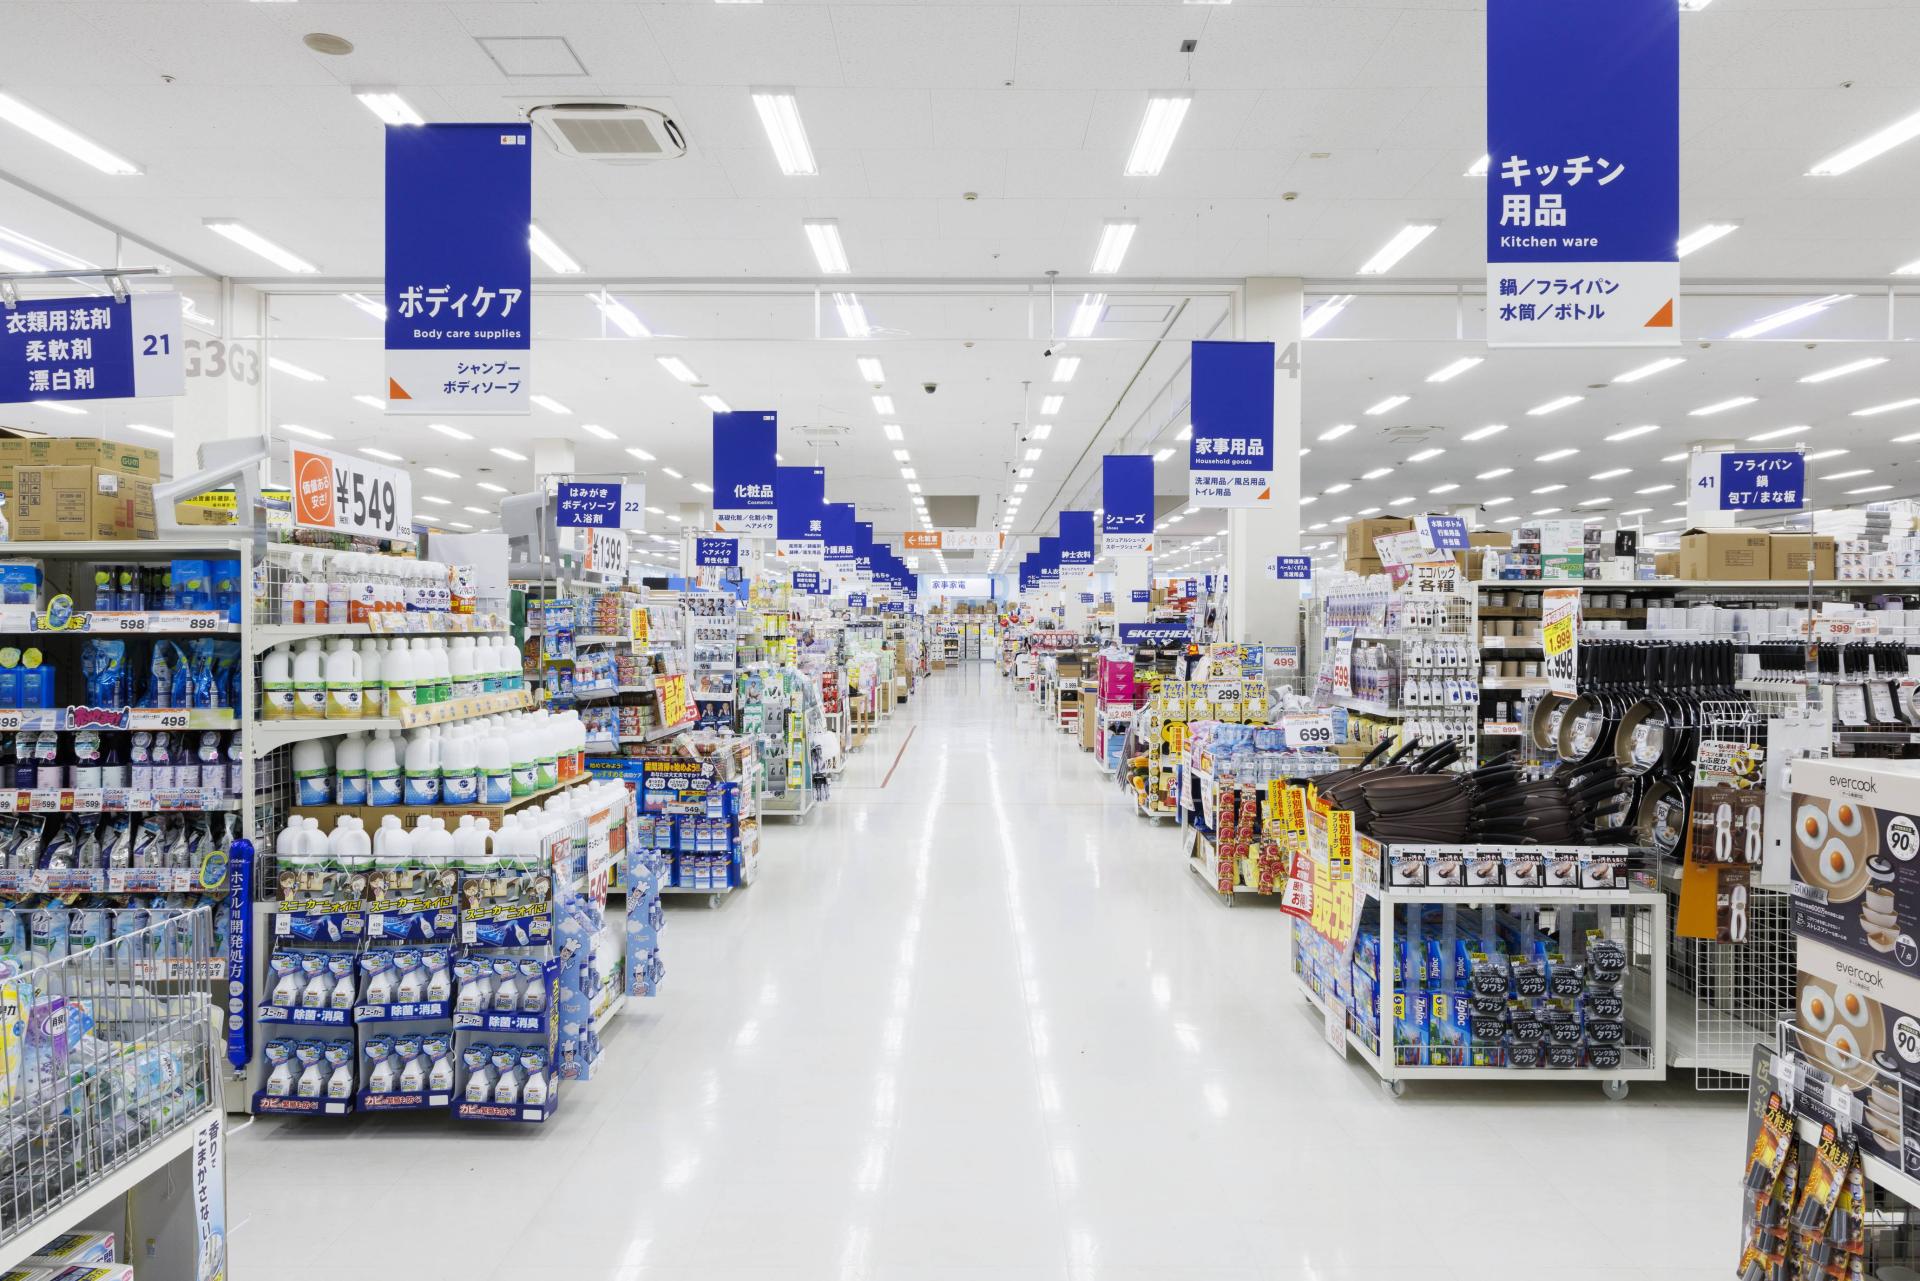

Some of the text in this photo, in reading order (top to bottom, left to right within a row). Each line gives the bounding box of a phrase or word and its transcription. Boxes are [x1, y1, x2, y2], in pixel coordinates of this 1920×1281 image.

[1500, 155, 1625, 187] キッチン
[1500, 194, 1566, 226] 用品
[1501, 236, 1598, 247] Kitchen ware
[1500, 277, 1619, 296] 鍋／フライパン
[398, 285, 522, 318] ボディケア
[1500, 303, 1605, 321] 水筒／ボトル
[6, 307, 111, 334] 衣類用洗剤
[413, 329, 442, 340] Body
[474, 329, 521, 340] supplies
[26, 338, 92, 362] 柔軟剤
[142, 334, 170, 356] 21
[457, 361, 520, 374] シャンプー
[29, 367, 95, 392] 漂白剤
[443, 380, 520, 394] ボディソープ
[1195, 438, 1264, 456] 家事用品
[1733, 459, 1793, 472] フライパン
[1698, 476, 1715, 489] 41
[1756, 474, 1769, 488] 鍋
[570, 488, 608, 498] はみがき
[734, 484, 773, 498] 化粧品
[1195, 488, 1232, 496] トイレ用品
[562, 501, 616, 511] ボディソープ
[625, 502, 639, 512] 22
[573, 514, 603, 524] 入浴剤
[1106, 513, 1146, 524] シューズ
[809, 520, 822, 532] 薬
[1061, 551, 1091, 559] 紳士衣料
[1418, 567, 1456, 579] エコバッグ
[1419, 579, 1456, 592] 各種
[120, 620, 145, 629] 598
[190, 619, 215, 628] 898
[1829, 624, 1850, 633] 399
[1273, 658, 1294, 666] 499
[1334, 666, 1349, 688] 599
[1218, 690, 1240, 700] 299
[0, 718, 18, 727] 98
[161, 717, 186, 727] 498
[1300, 727, 1330, 741] 699
[1829, 774, 1877, 794] evercook
[0, 800, 10, 809] 99
[42, 801, 56, 809] 599
[85, 800, 100, 809] 599
[1292, 790, 1305, 829] 特別価格
[1339, 813, 1351, 857] 特別価格
[230, 871, 243, 977] ホテル用開発処方
[1431, 957, 1439, 978] Ziploc
[1456, 957, 1465, 977] Ziploc
[1601, 958, 1624, 967] タワシ
[1836, 960, 1884, 989] evercook
[1480, 983, 1507, 992] タワシ
[1521, 984, 1545, 993] タワシ
[1556, 985, 1581, 994] タワシ
[260, 1006, 286, 1019] スニーカー
[293, 1008, 345, 1023] 除菌・消臭
[358, 1006, 384, 1018] スニーカー
[390, 1003, 443, 1017] 除菌・消臭
[1415, 997, 1426, 1026] Ziploc
[1457, 997, 1468, 1026] Ziploc
[457, 1014, 483, 1027] スニーカー
[488, 1016, 539, 1030] 除菌・消臭
[209, 1120, 220, 1168] 香りで
